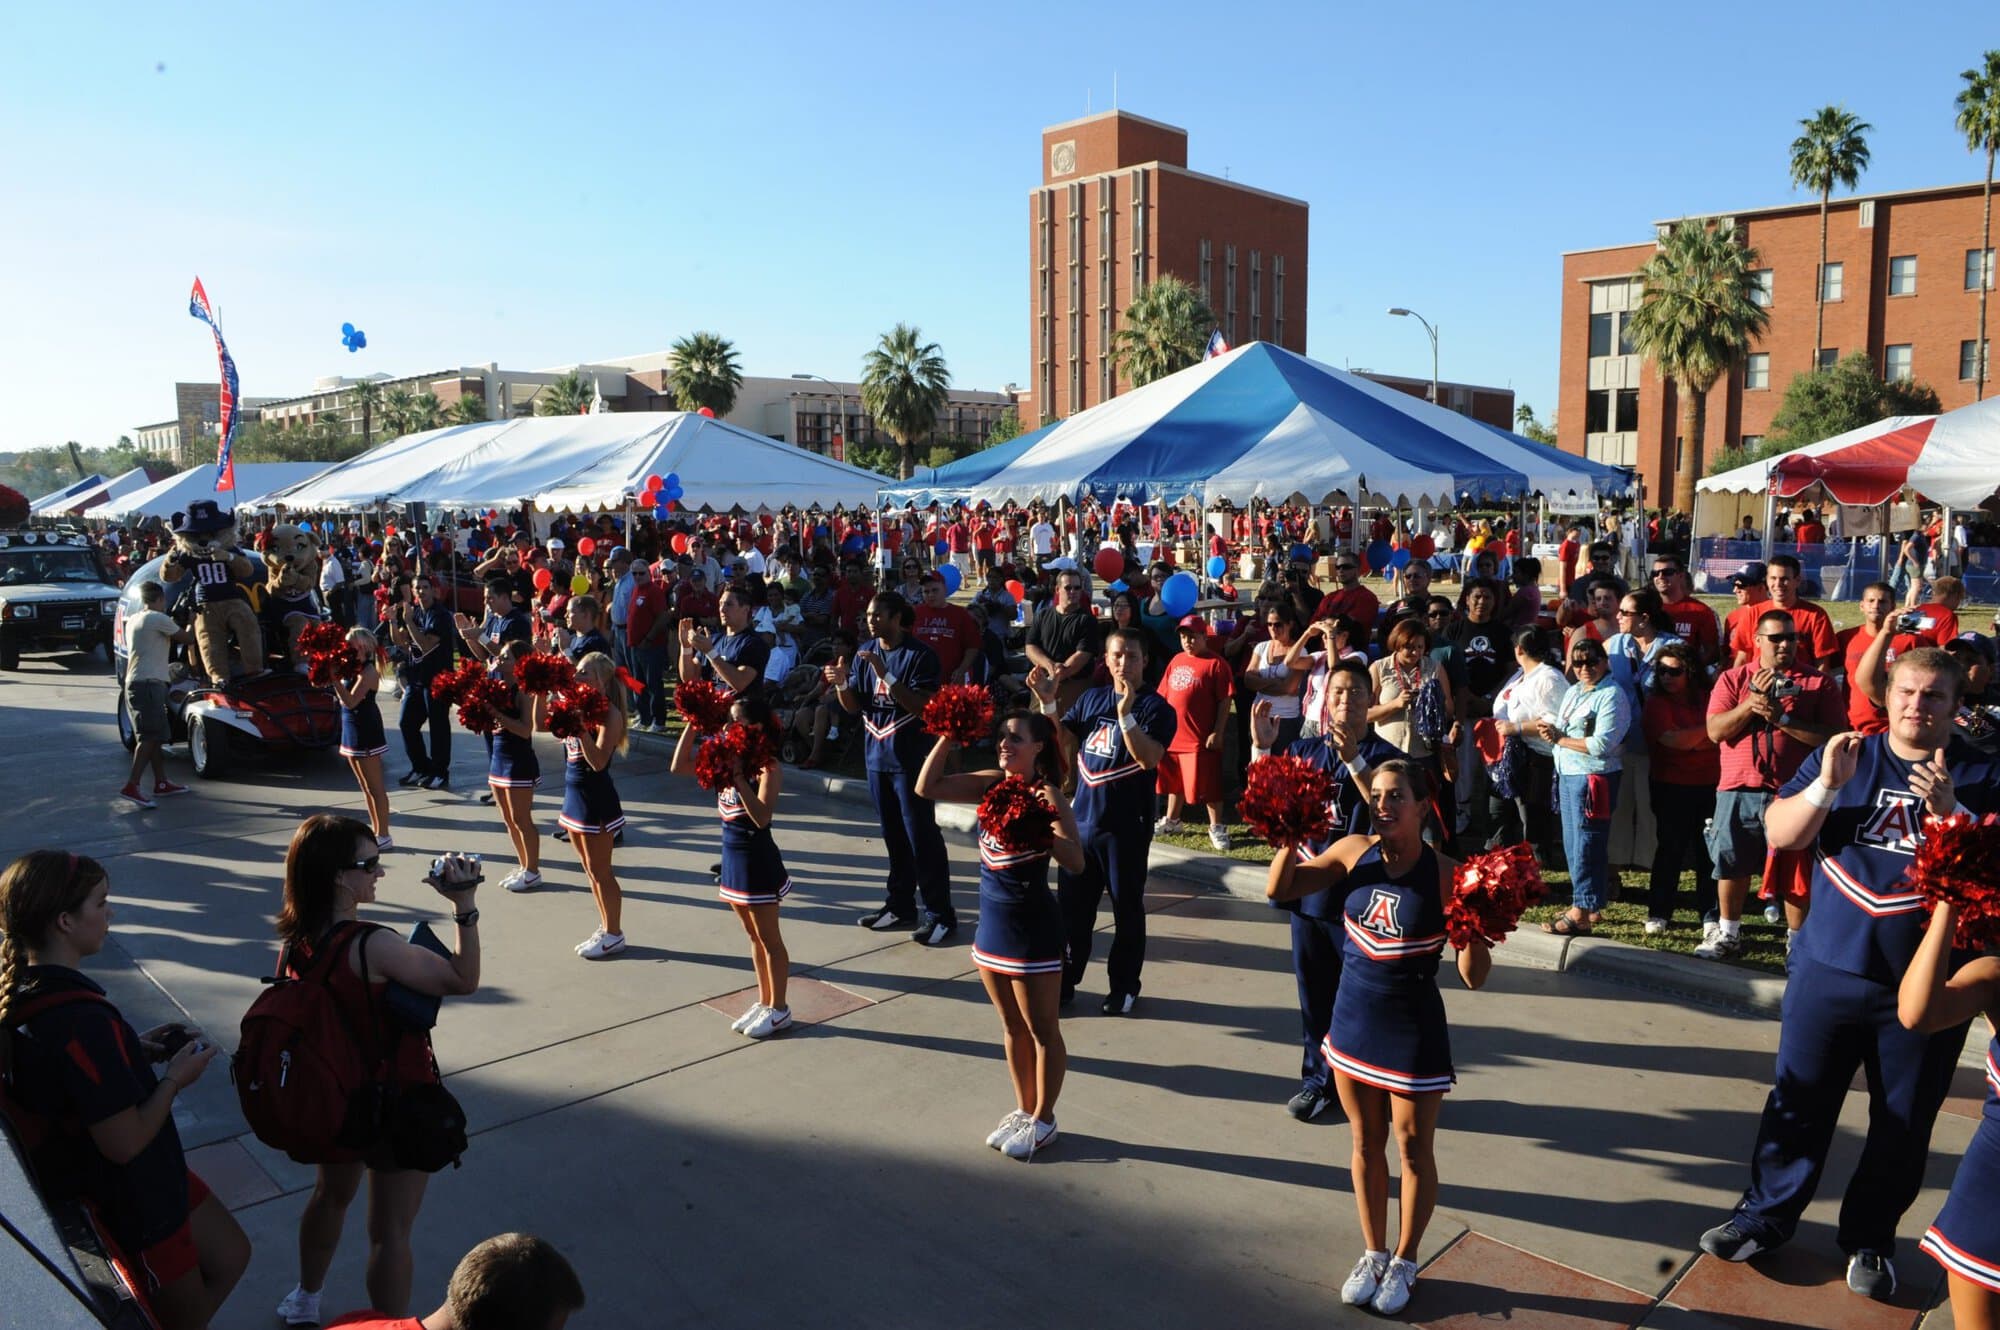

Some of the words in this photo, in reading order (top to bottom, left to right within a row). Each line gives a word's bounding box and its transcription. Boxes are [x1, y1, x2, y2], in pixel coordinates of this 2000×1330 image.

[1675, 622, 1692, 633] FAN
[1084, 716, 1117, 760] A
[1855, 788, 1927, 857] A
[1358, 889, 1404, 940] A
